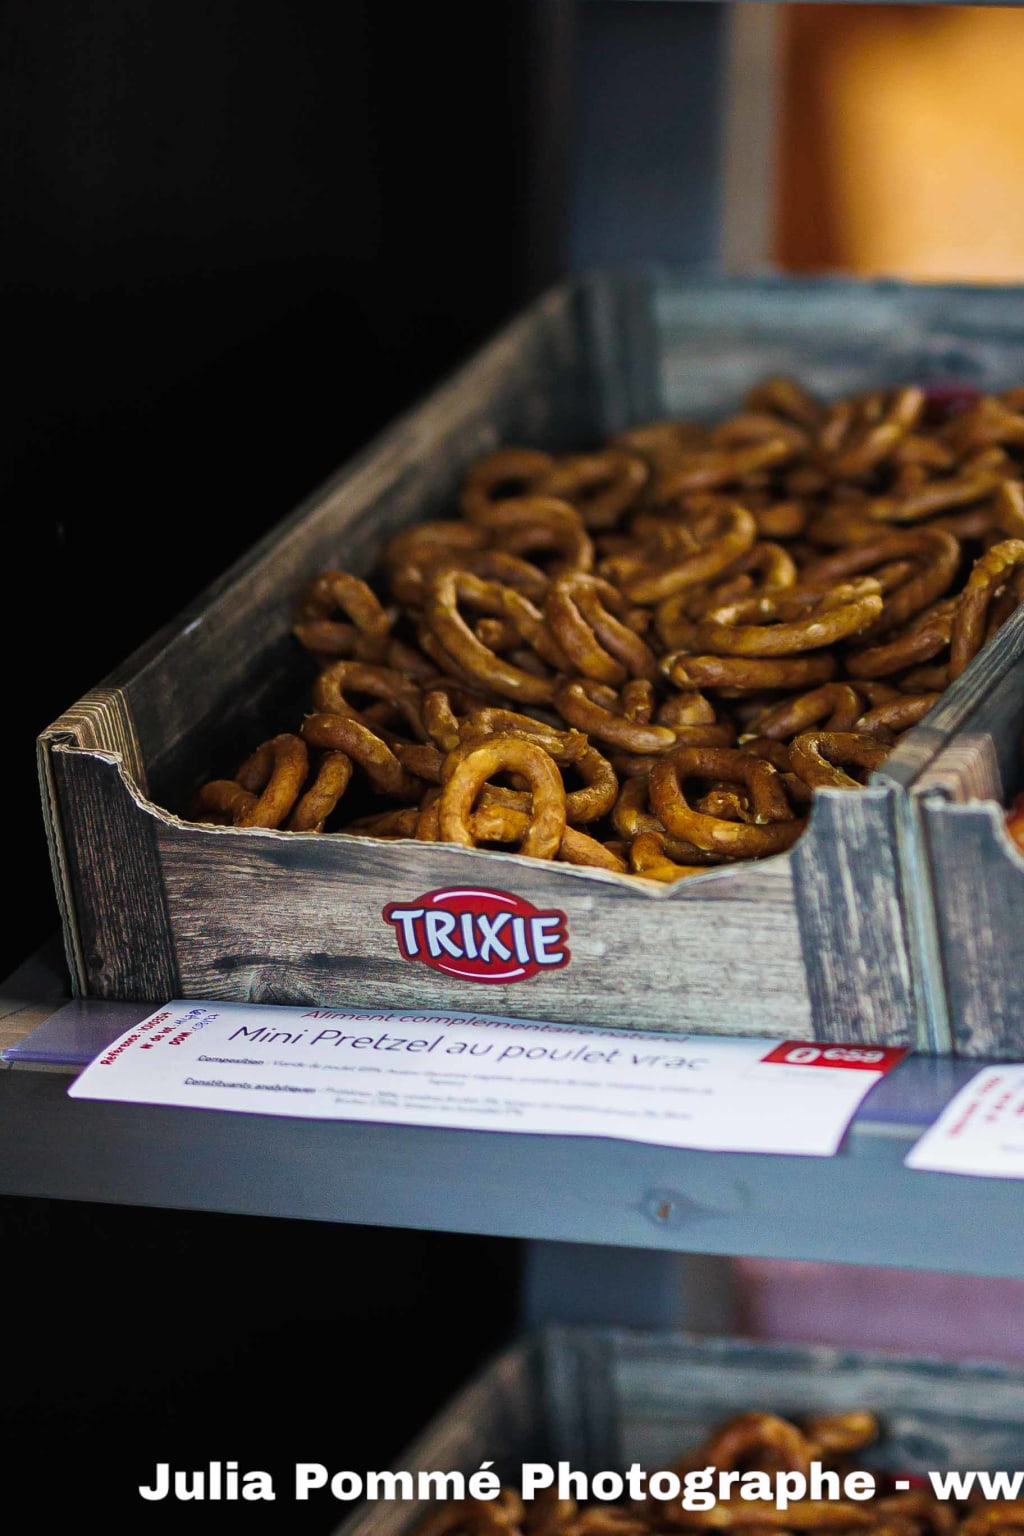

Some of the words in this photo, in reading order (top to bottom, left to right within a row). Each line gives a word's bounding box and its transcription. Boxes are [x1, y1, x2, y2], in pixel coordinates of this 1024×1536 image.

[391, 909, 564, 964] TRIXIE
[301, 1009, 395, 1023] Aliment
[398, 1013, 595, 1036] complémentaire
[228, 1025, 308, 1045] Mini
[310, 1029, 445, 1053] Pretzel
[445, 1039, 495, 1057] au
[497, 1044, 622, 1063] poulet
[631, 1052, 711, 1071] vrac
